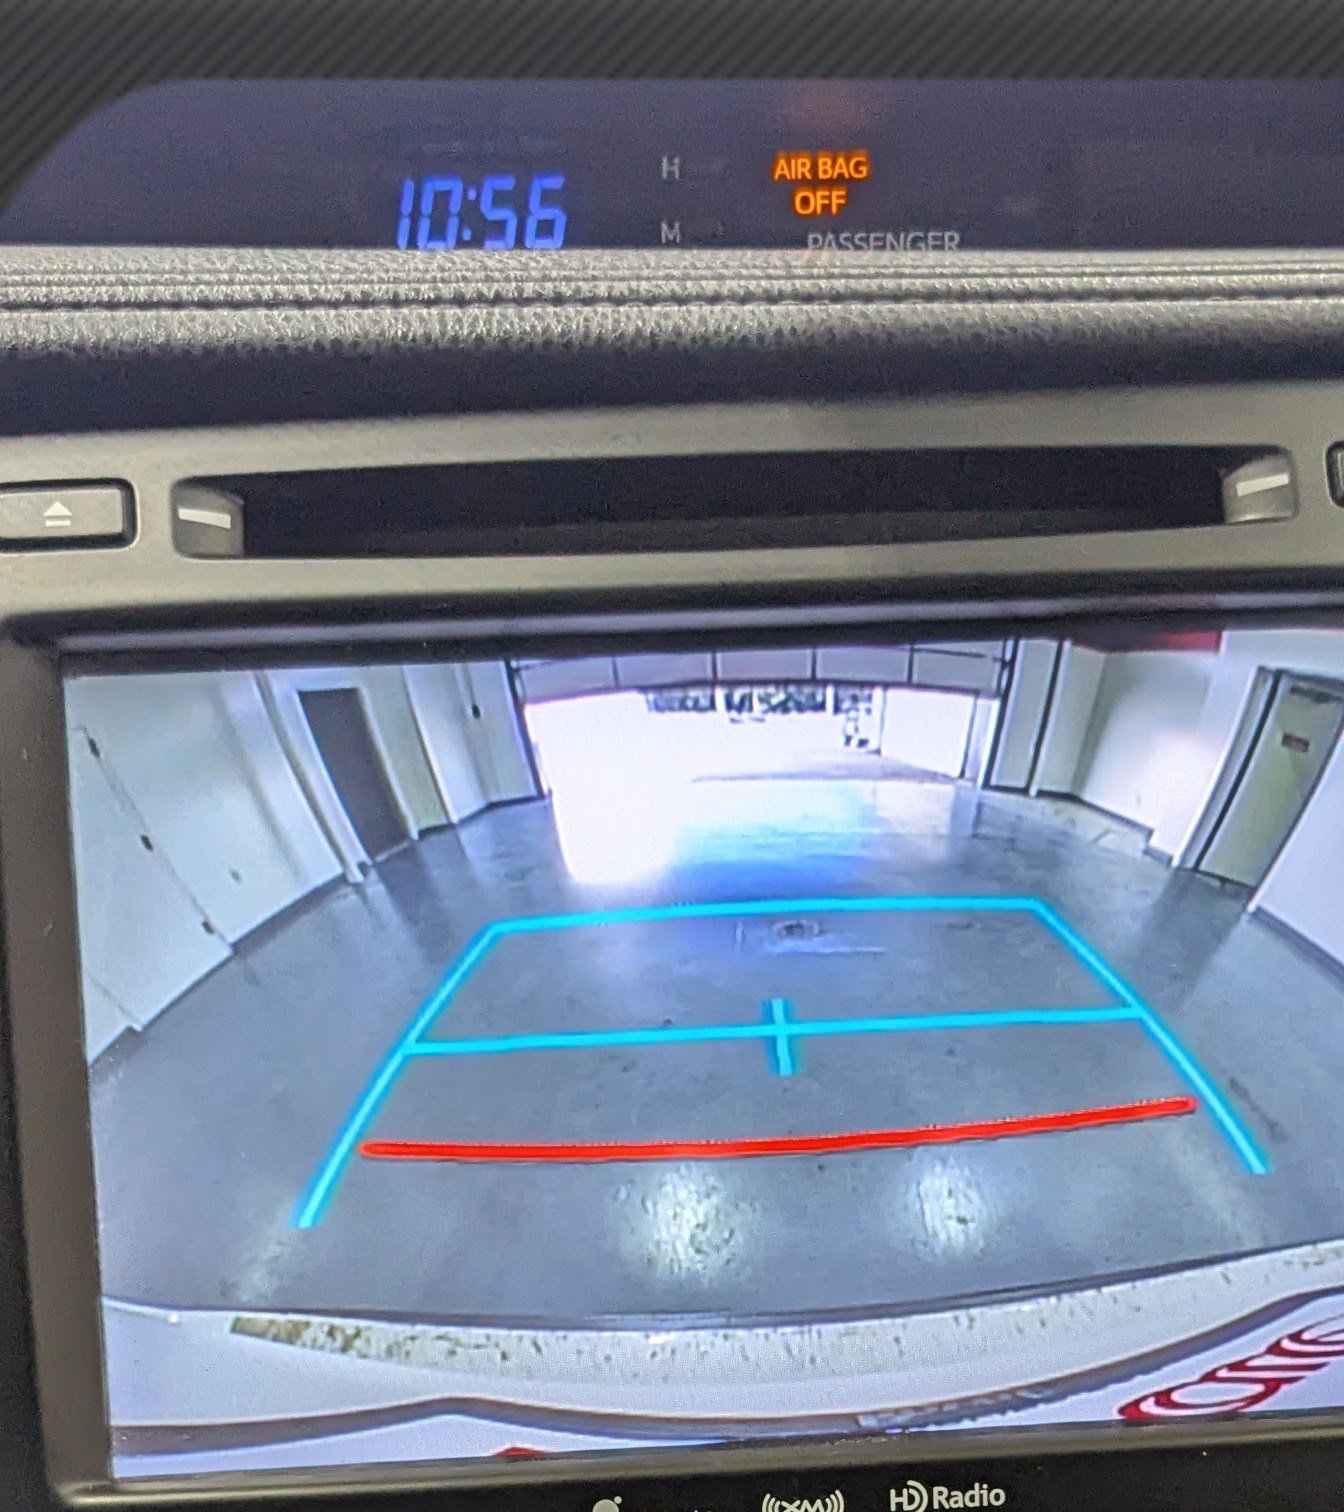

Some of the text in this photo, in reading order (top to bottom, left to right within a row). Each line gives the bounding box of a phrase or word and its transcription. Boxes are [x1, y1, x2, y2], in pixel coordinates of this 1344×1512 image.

[660, 155, 681, 181] H
[774, 152, 869, 181] AIR BAG
[396, 174, 568, 250] 10:56
[794, 189, 847, 216] OFF
[660, 220, 682, 244] M
[807, 230, 961, 250] PASSENGER
[932, 1482, 1006, 1511] Radio
